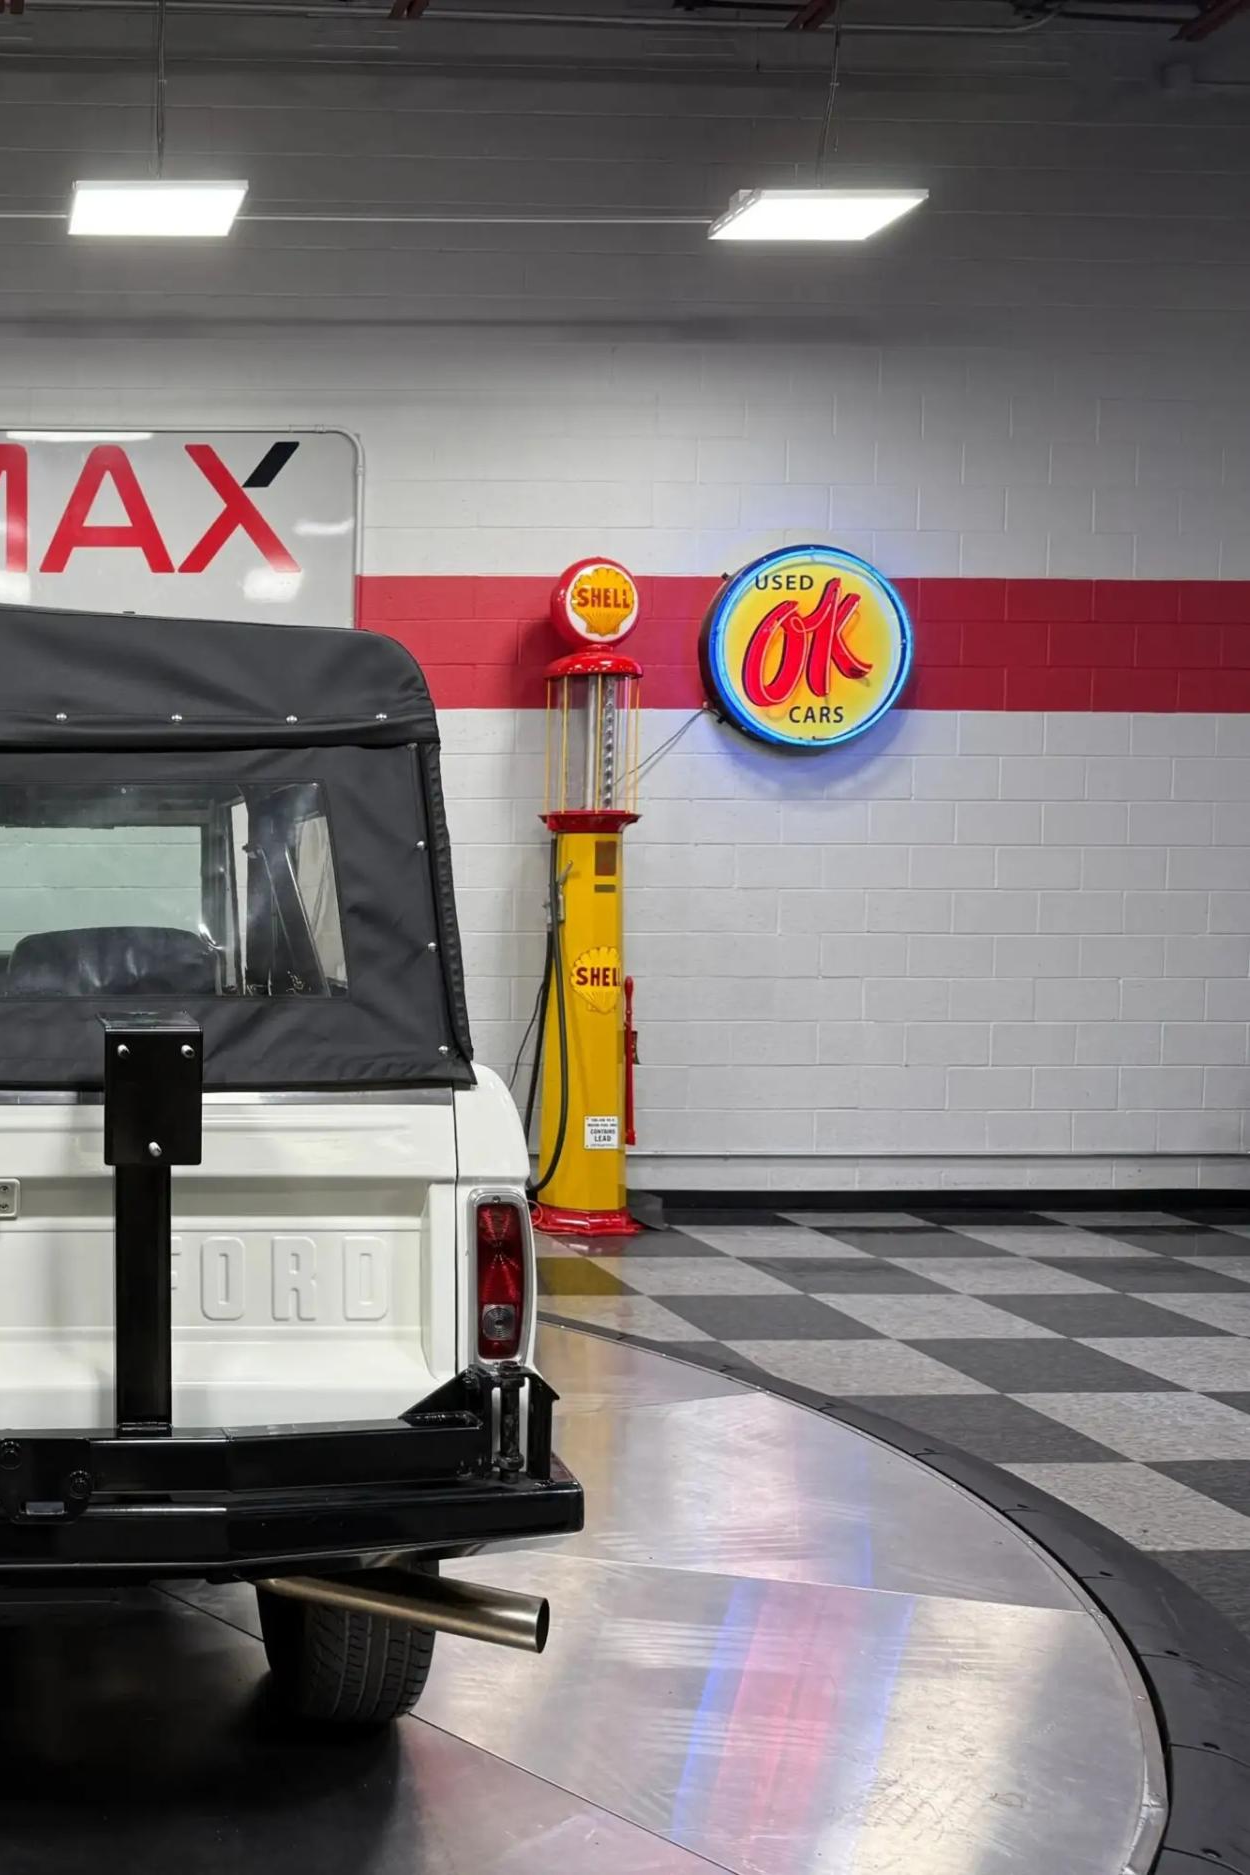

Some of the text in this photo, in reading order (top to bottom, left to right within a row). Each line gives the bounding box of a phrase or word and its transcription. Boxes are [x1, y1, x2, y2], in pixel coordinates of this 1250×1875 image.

[755, 575, 814, 591] USED
[576, 586, 630, 609] SHELL
[741, 577, 874, 708] OK
[789, 706, 844, 724] CARS
